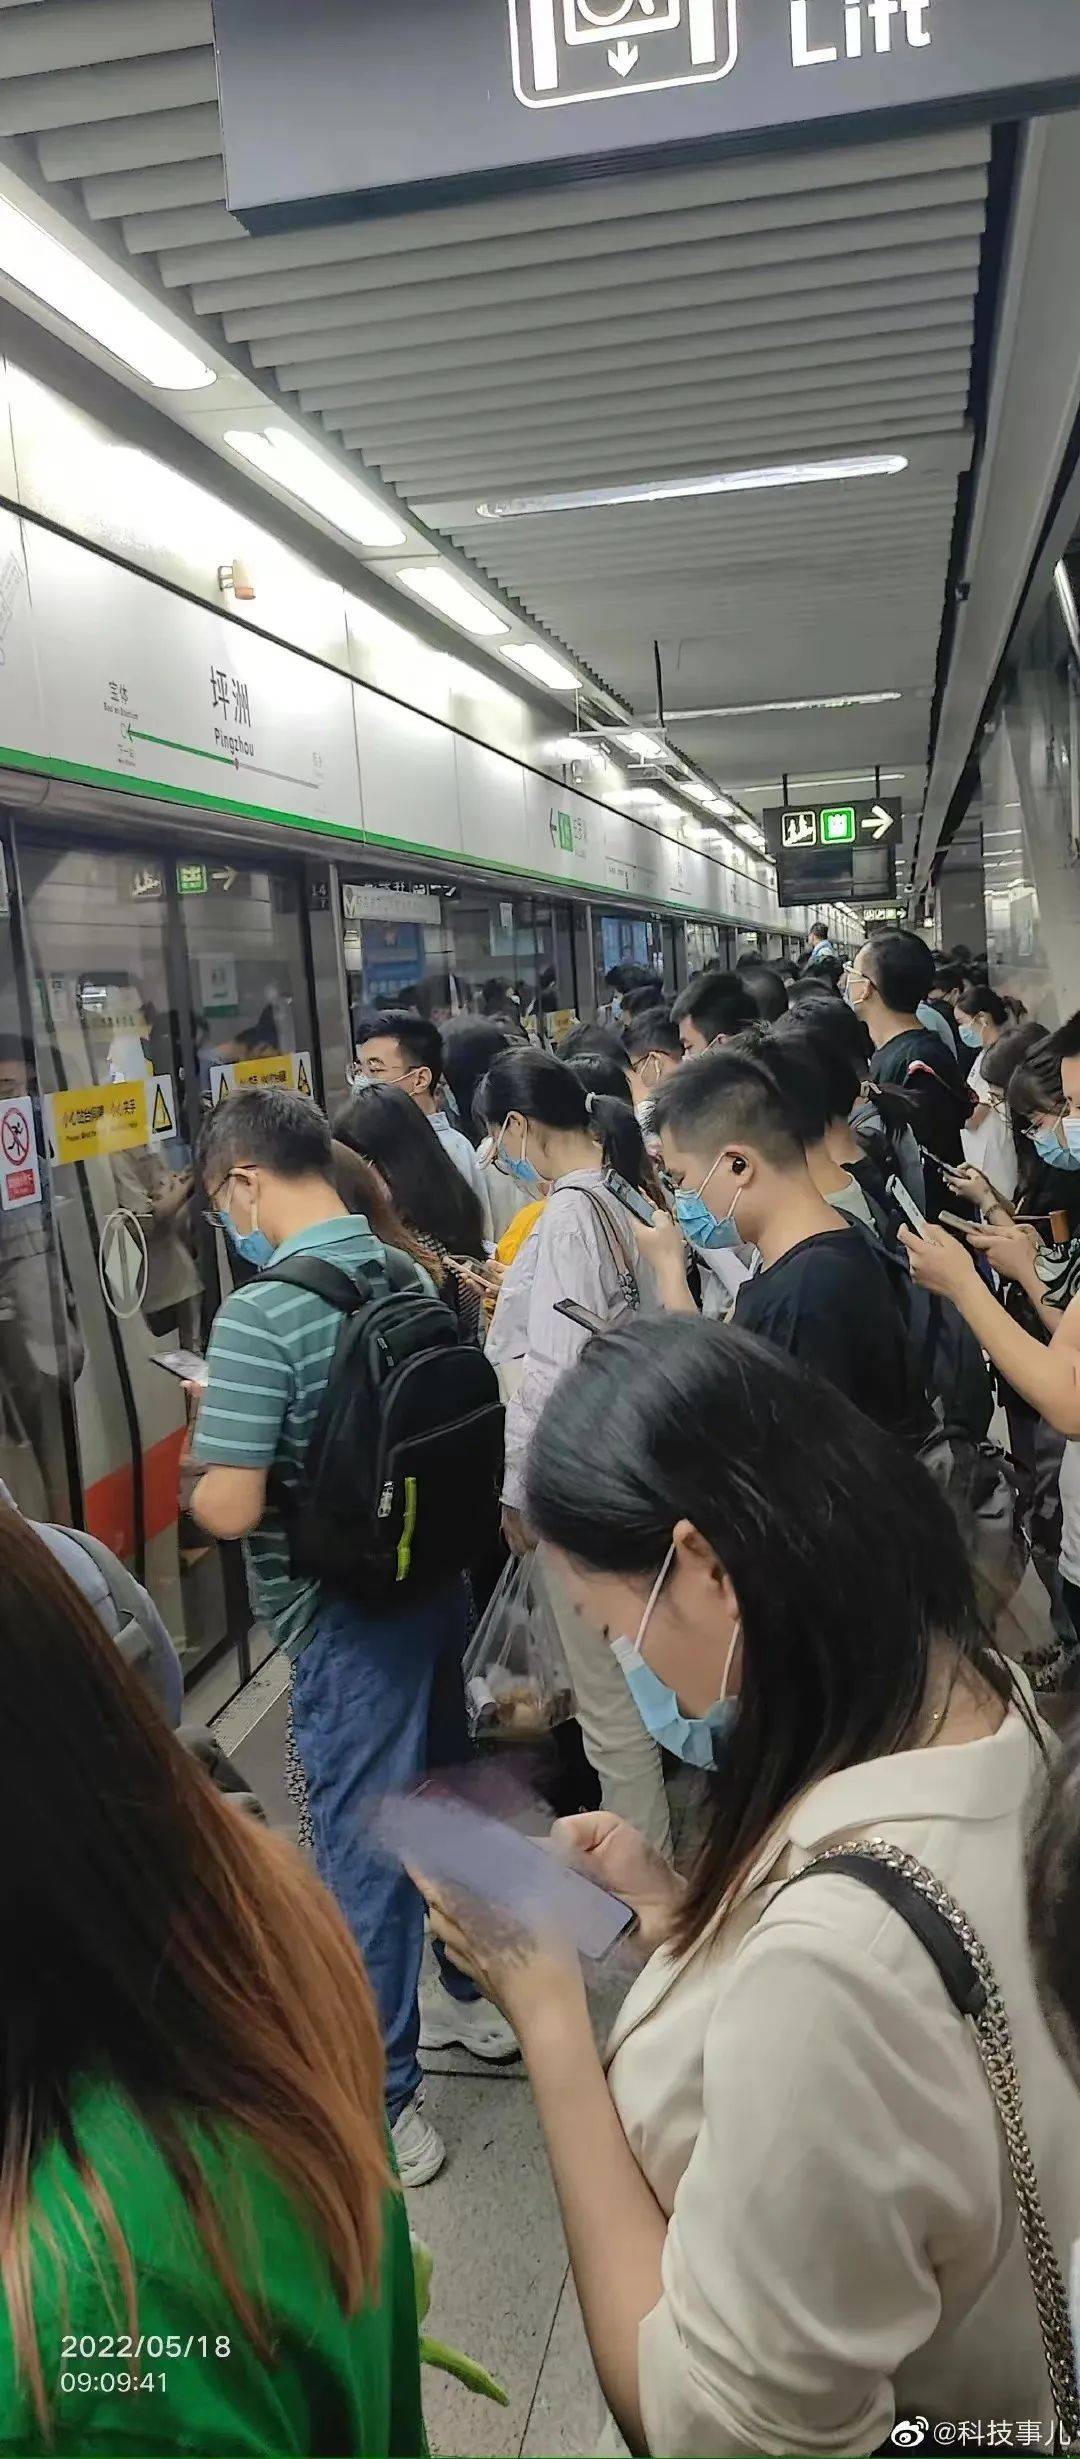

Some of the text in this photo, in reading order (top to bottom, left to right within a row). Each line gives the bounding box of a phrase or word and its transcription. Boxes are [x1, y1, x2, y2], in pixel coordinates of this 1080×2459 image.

[791, 0, 931, 67] Lift
[210, 665, 252, 727] 坪洲
[214, 727, 255, 757] Pingzhou
